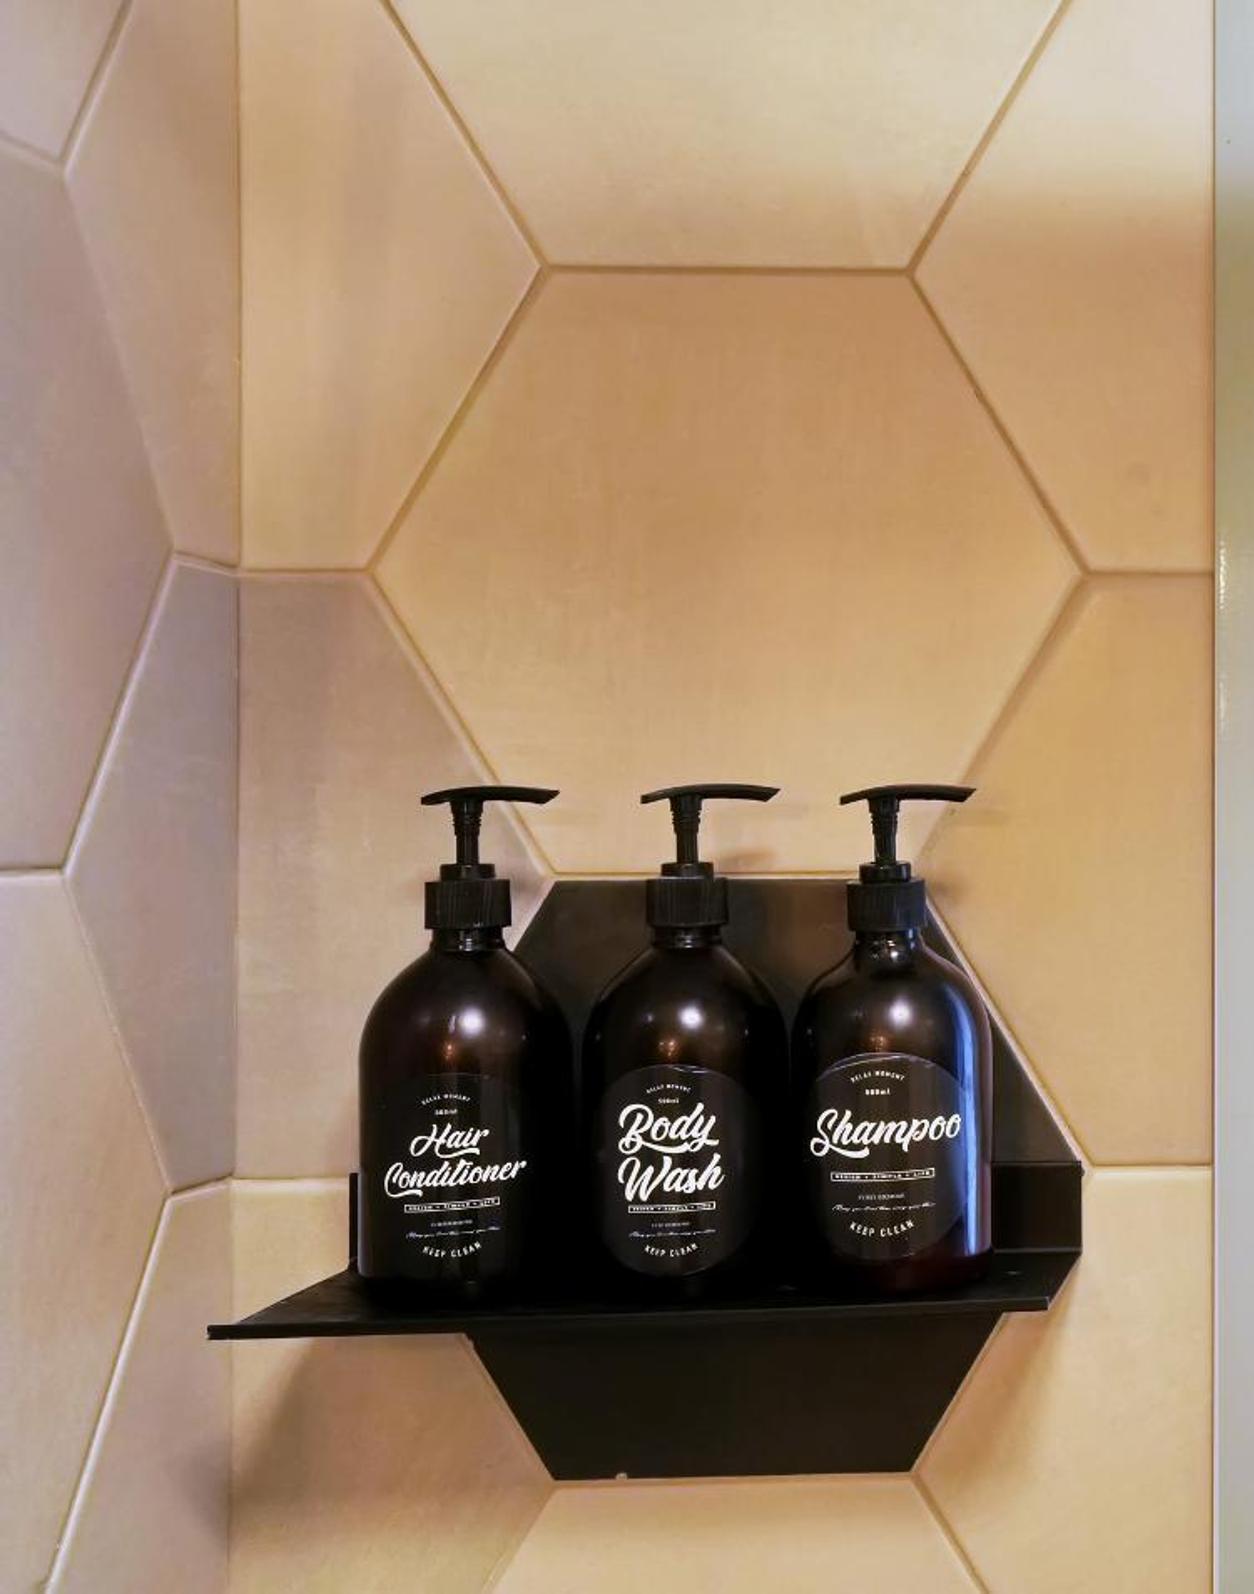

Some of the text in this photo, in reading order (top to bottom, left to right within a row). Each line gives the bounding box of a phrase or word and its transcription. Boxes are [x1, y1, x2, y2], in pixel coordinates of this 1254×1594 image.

[409, 1123, 490, 1158] Hair
[618, 1102, 720, 1154] Body
[810, 1108, 962, 1159] Shampoo
[384, 1158, 528, 1198] Conditioner
[617, 1152, 725, 1202] Wash
[850, 1219, 914, 1238] KEEP CLEAN
[422, 1240, 482, 1258] KEEP CLEAN
[644, 1242, 699, 1258] KEEP CLEAN
